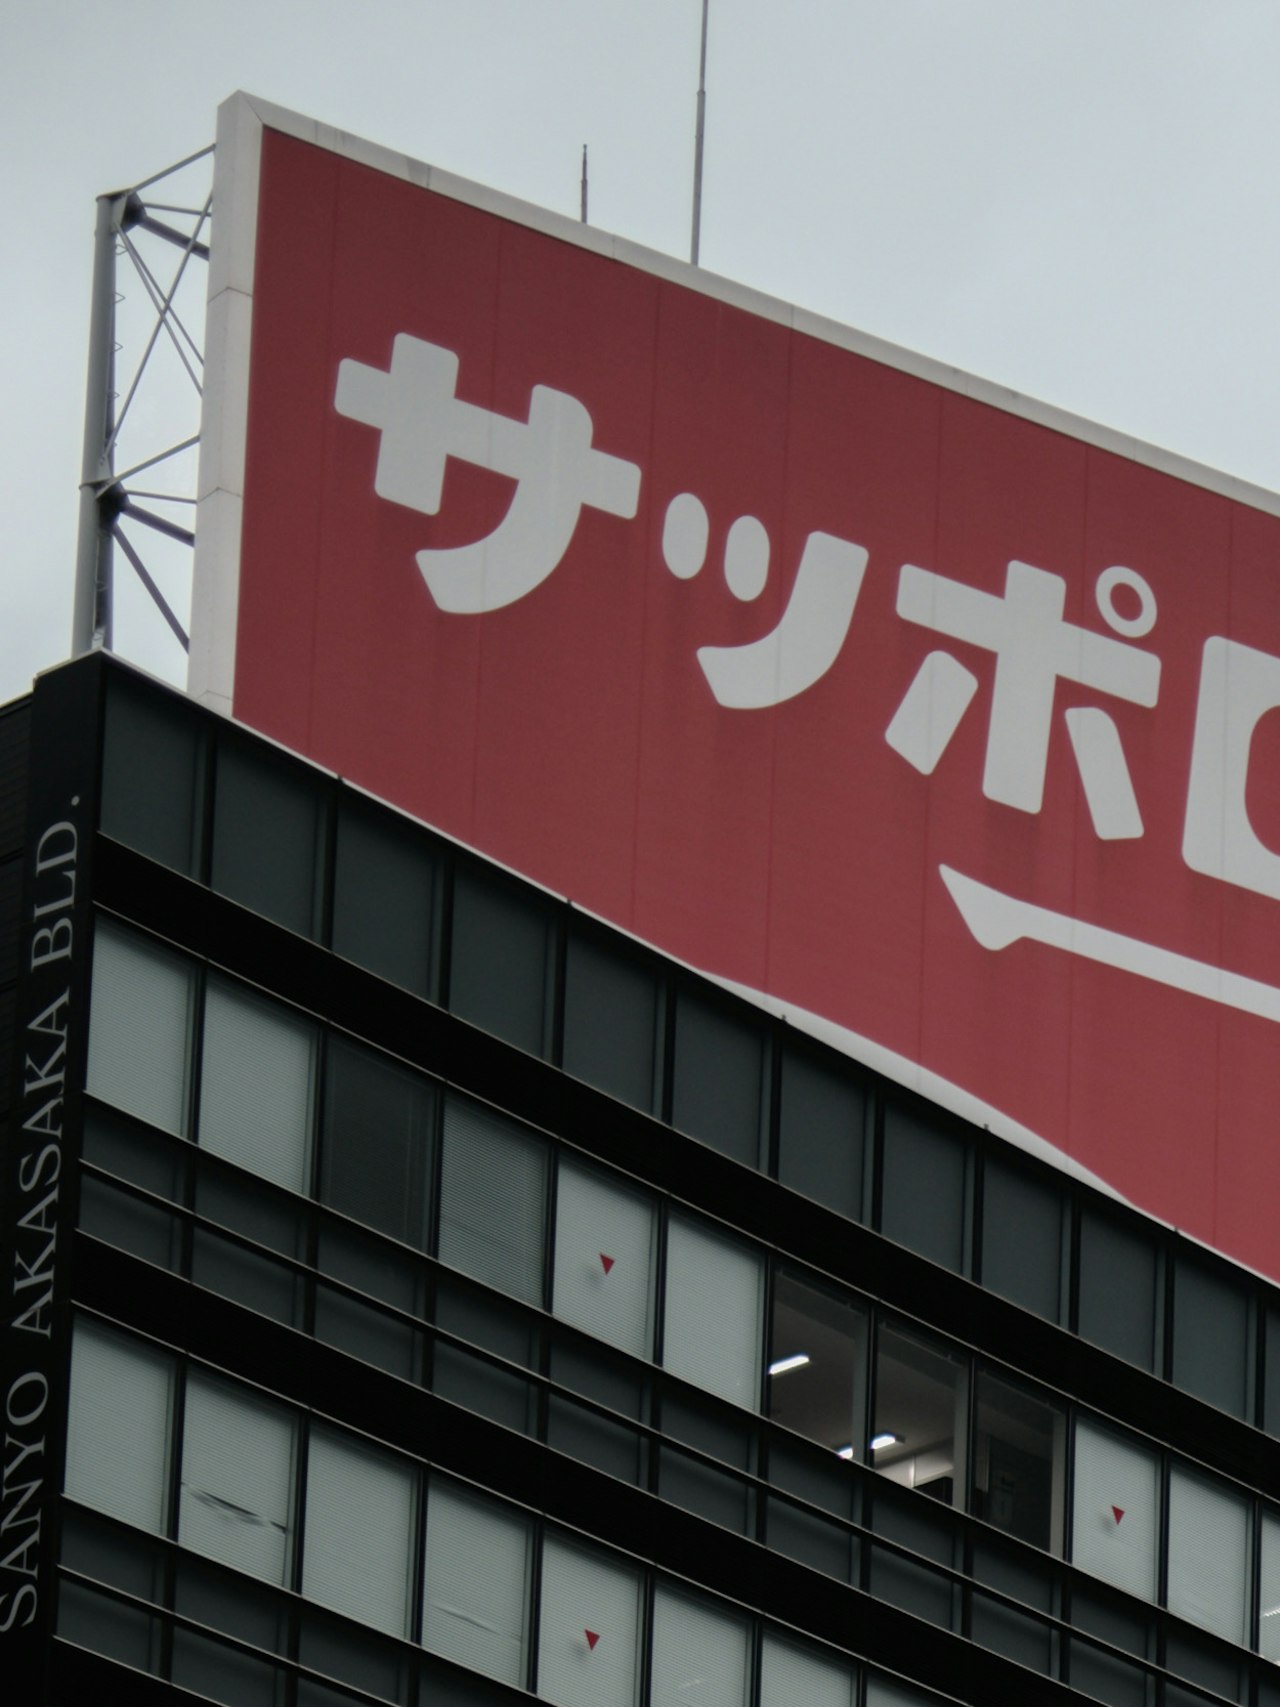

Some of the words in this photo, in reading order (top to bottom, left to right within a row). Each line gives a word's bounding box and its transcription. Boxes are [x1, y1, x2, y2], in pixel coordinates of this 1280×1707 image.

[30, 794, 81, 974] BLD.
[11, 985, 71, 1339] AKASAKA
[0, 1371, 49, 1633] SANYO
